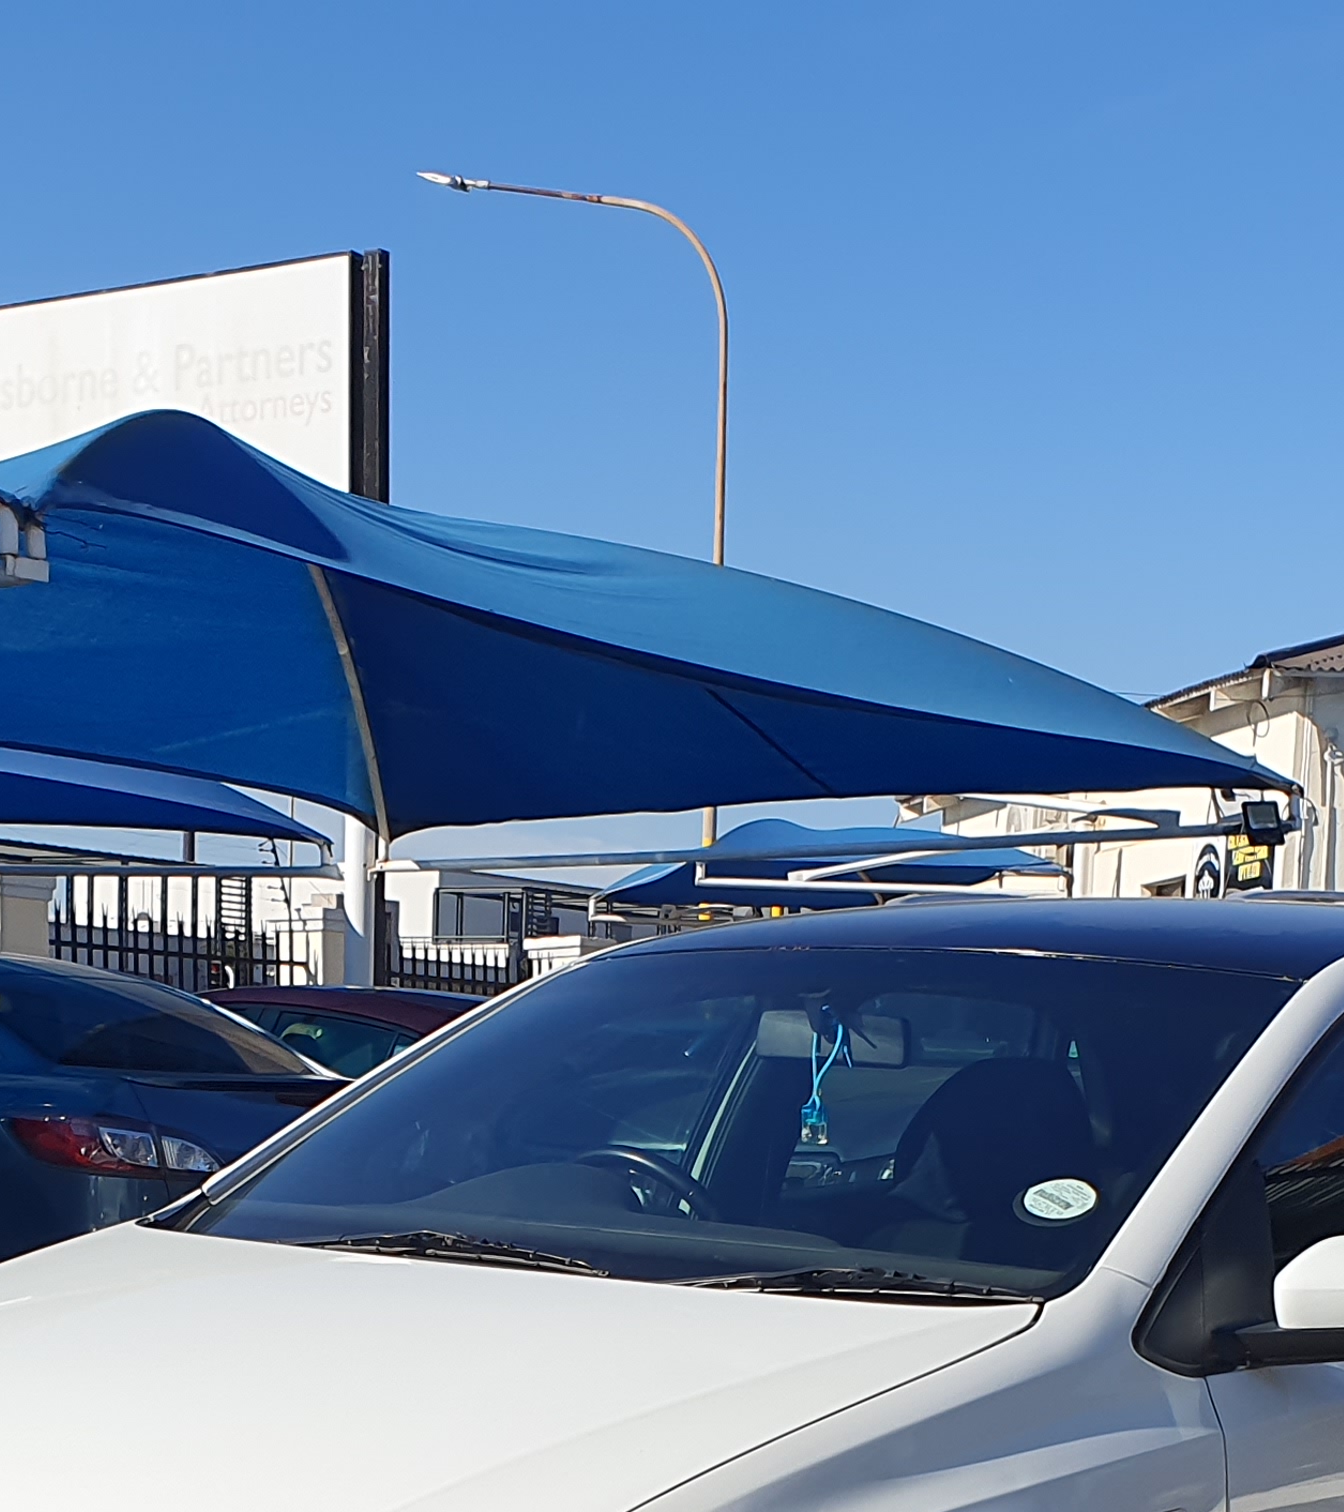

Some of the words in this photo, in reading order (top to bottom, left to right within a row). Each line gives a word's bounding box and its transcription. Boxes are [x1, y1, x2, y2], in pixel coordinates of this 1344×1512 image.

[132, 350, 161, 396] &
[175, 338, 333, 391] Partners
[201, 389, 333, 426] Attorneys
